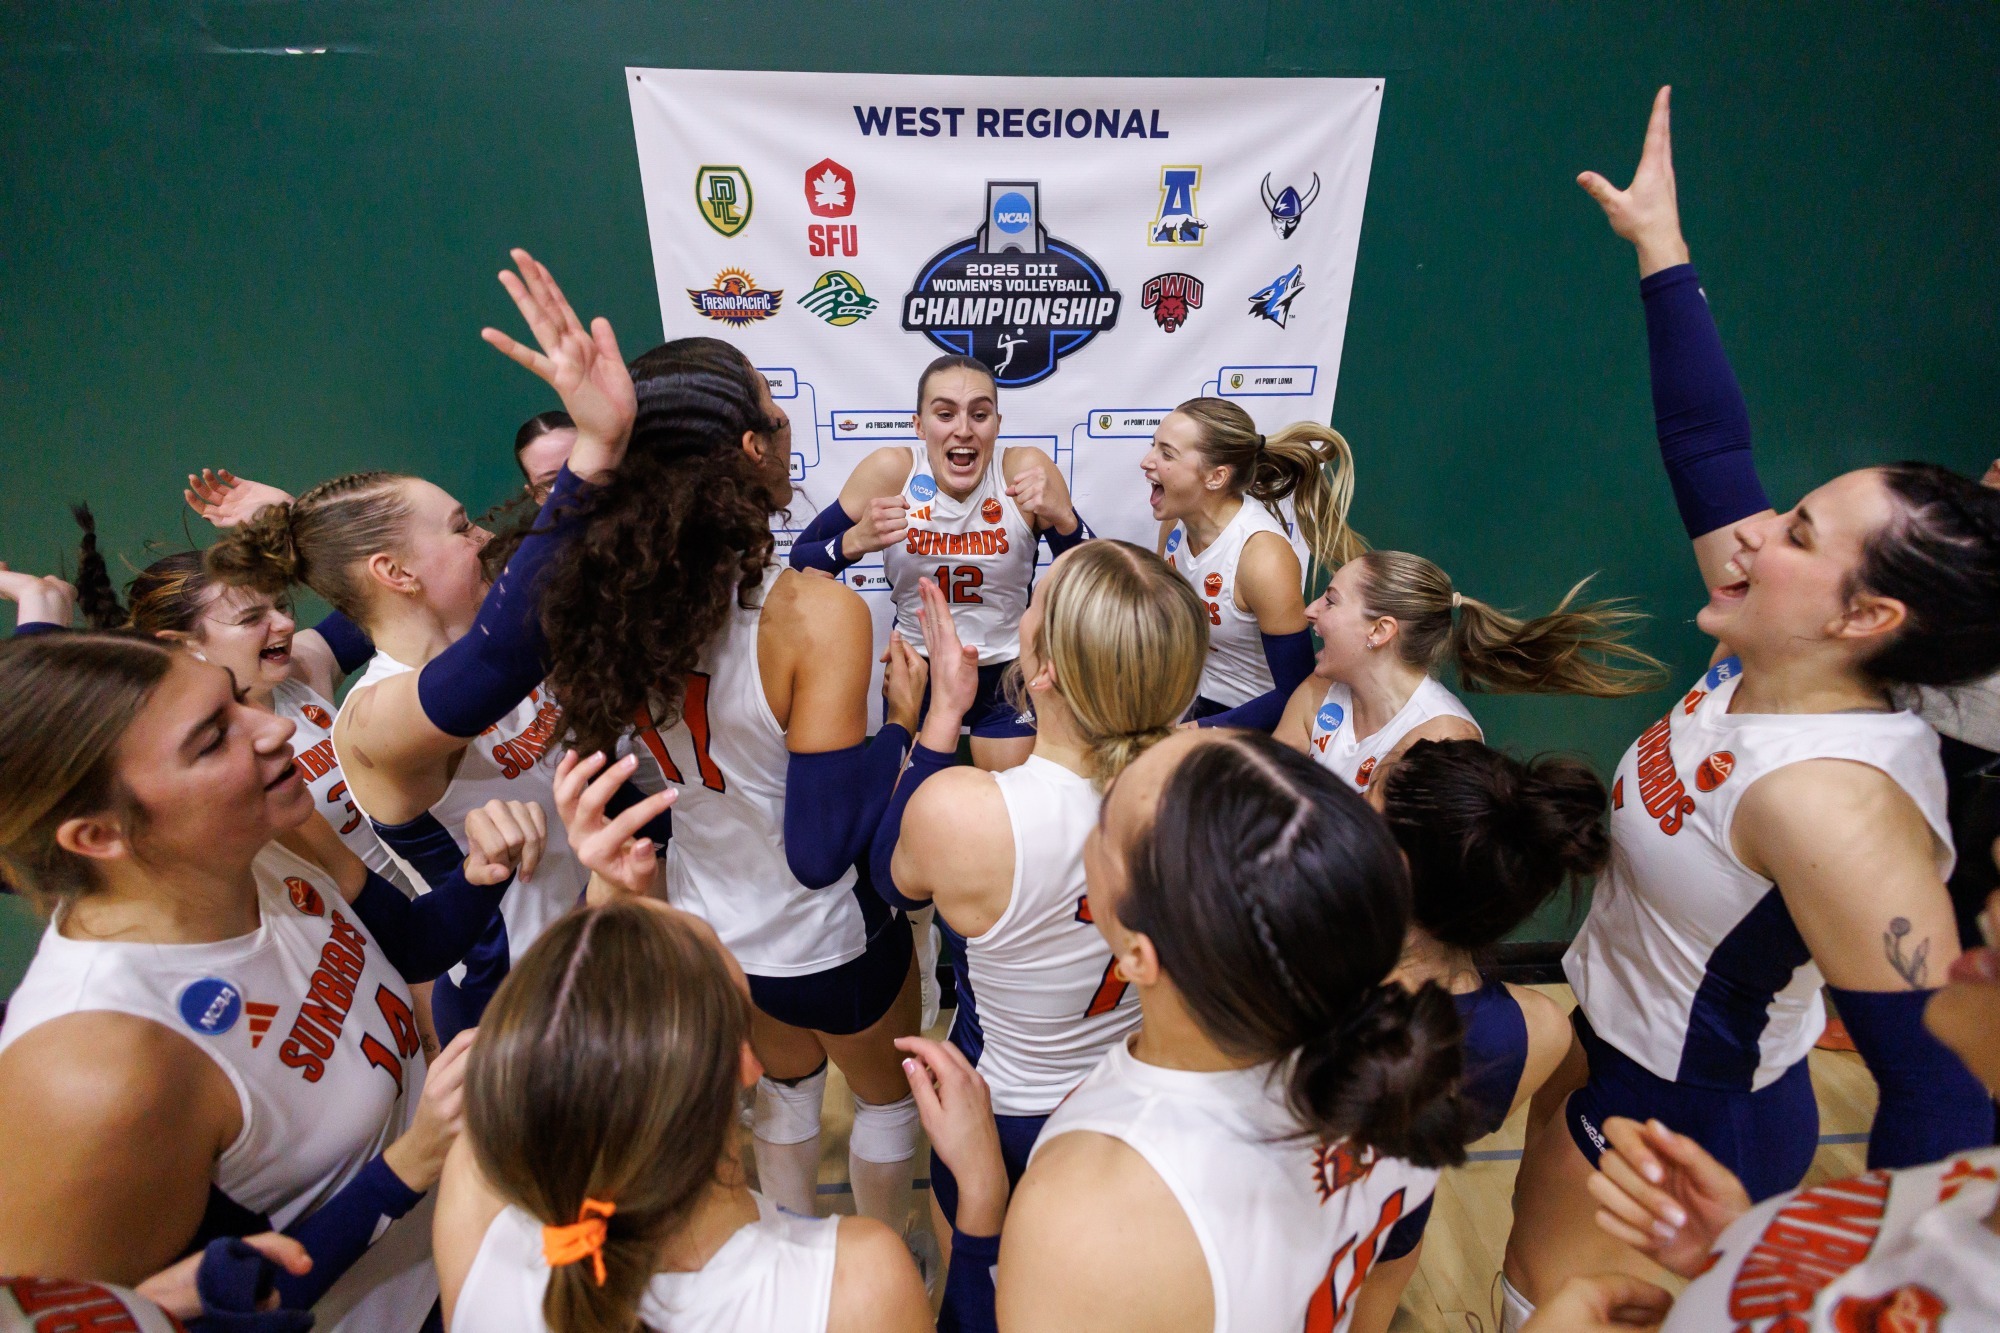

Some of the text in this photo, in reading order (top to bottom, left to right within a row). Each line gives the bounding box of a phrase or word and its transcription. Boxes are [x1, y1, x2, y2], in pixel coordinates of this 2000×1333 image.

[853, 105, 1170, 139] WEST REGIONAL
[998, 212, 1030, 224] NCAA
[808, 224, 859, 257] SFU
[965, 264, 1058, 276] 2025 DII
[932, 279, 1091, 292] WOMEN'S VOLLEYBALL
[1143, 274, 1202, 308] CWU
[701, 293, 771, 310] FRESNO PACIFIC
[908, 297, 1115, 326] CHAMPIONSHIP
[768, 379, 783, 387] CIFIC
[1254, 377, 1293, 385] #1 POINT LOMA
[865, 421, 873, 429] #3
[874, 421, 894, 429] FRESNO
[894, 421, 914, 429] PACIFIC
[1123, 418, 1130, 426] #1
[1130, 418, 1145, 426] POINT
[912, 484, 934, 498] NCAA
[906, 527, 1010, 556] SUNBIRDS
[933, 565, 984, 604] 12
[1319, 711, 1340, 728] NCAA
[279, 909, 367, 1083] SUNBIRDS
[200, 986, 237, 1031] NCAA
[359, 982, 421, 1104] 14
